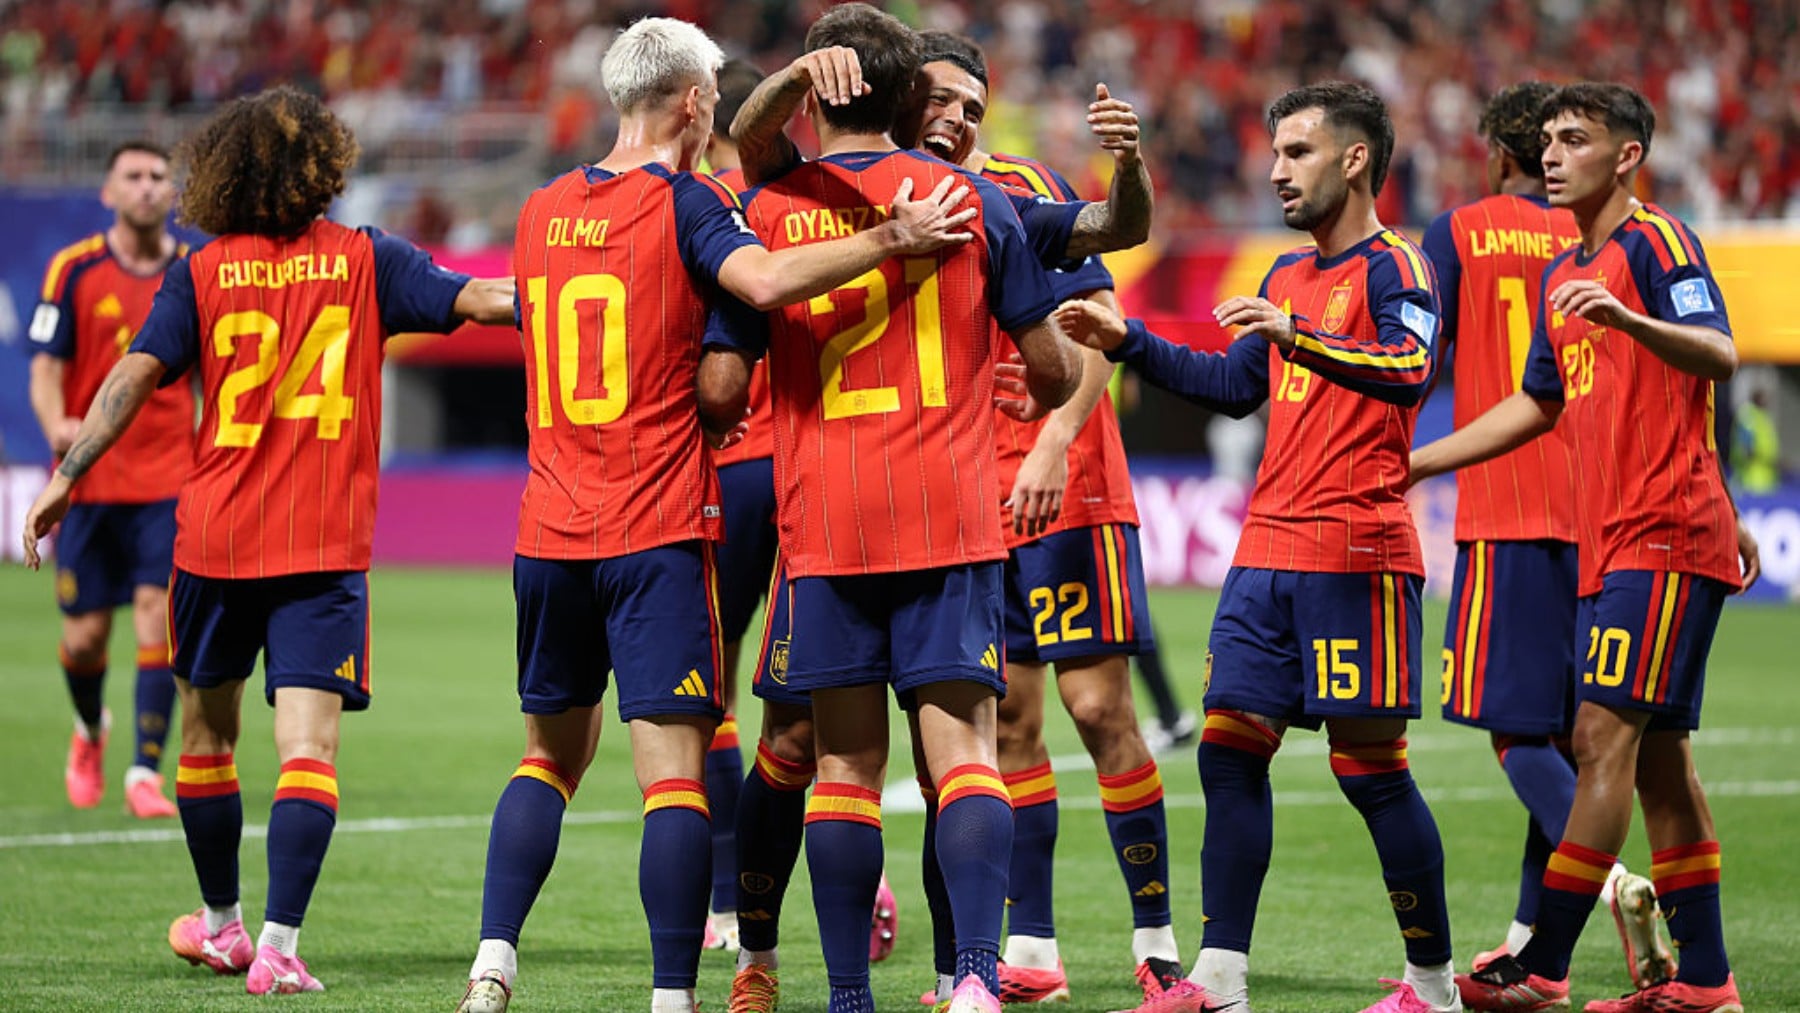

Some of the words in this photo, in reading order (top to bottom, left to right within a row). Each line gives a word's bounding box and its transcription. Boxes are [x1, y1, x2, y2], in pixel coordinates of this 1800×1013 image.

[546, 217, 609, 247] OLMO
[1469, 229, 1555, 260] LAMINE
[218, 253, 349, 290] CUCURELLA
[526, 273, 628, 429] 10
[808, 258, 948, 421] 21
[1498, 276, 1533, 394] 1
[213, 304, 354, 448] 24
[1276, 360, 1312, 402] 15
[1028, 581, 1093, 647] 22
[1312, 638, 1360, 699] 15
[1583, 625, 1632, 688] 20
